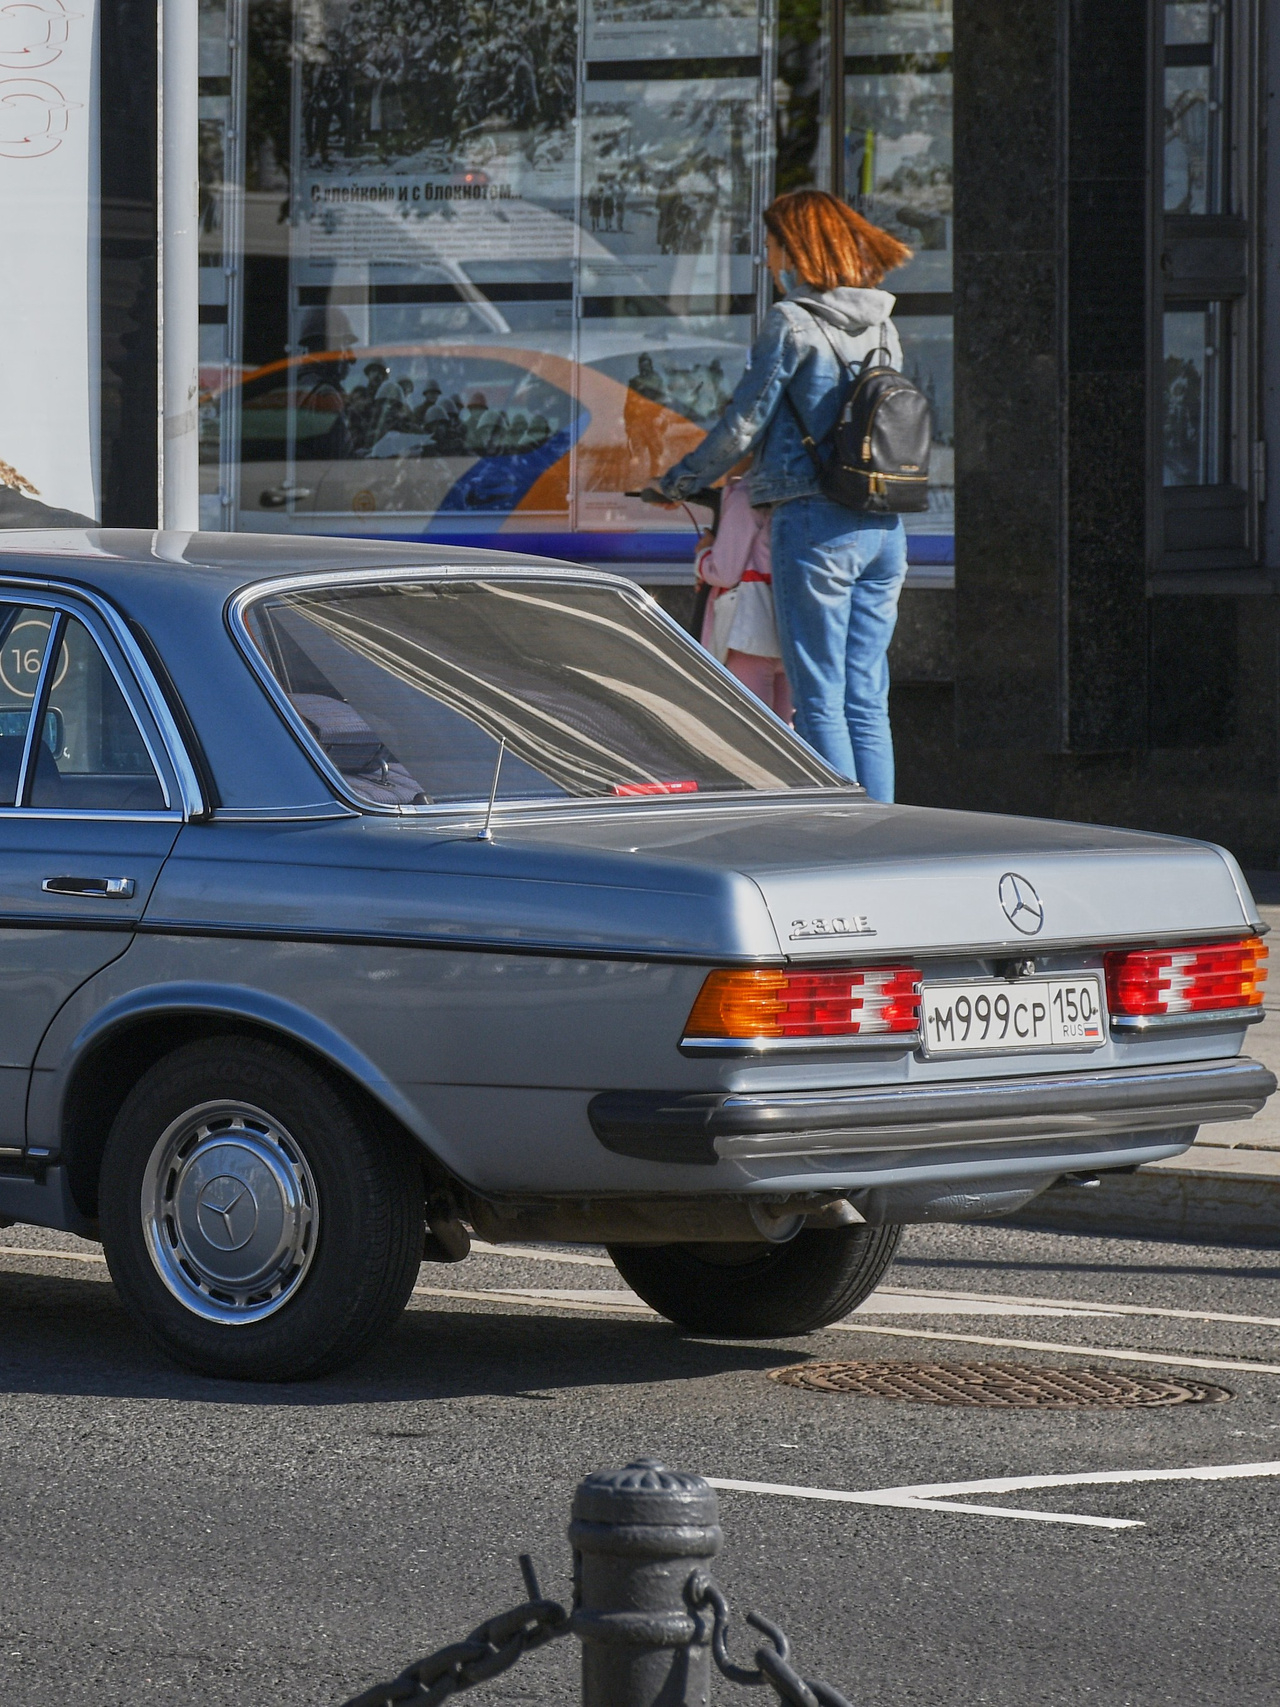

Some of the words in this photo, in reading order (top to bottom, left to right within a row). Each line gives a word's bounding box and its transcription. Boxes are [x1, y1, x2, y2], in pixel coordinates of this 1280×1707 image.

[310, 184, 321, 201] С
[398, 185, 409, 200] и
[412, 185, 421, 200] с
[791, 915, 872, 936] 230E
[1052, 987, 1092, 1023] 150
[1062, 1024, 1084, 1038] RUS
